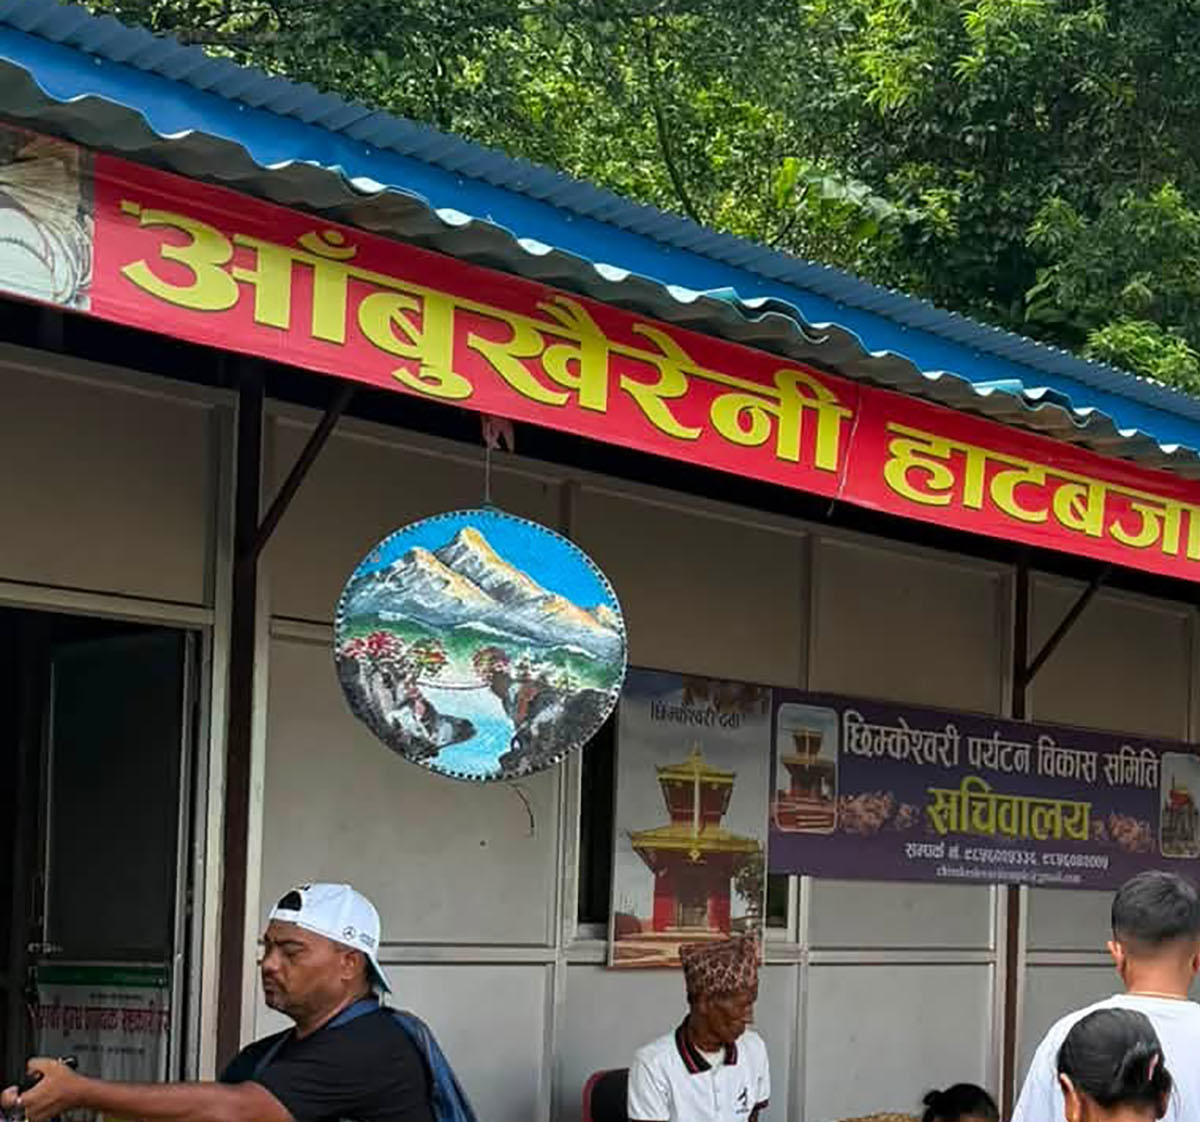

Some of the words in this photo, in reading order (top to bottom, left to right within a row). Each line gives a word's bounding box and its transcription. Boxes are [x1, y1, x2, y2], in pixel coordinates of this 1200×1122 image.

[120, 199, 852, 471] आँबुखैरेनी
[842, 709, 960, 768] छिम्केश्वरी
[967, 731, 1033, 775] पर्यटन
[1037, 735, 1099, 783] विकास
[1103, 745, 1160, 790] समिति
[926, 776, 1092, 842] सचिवालय
